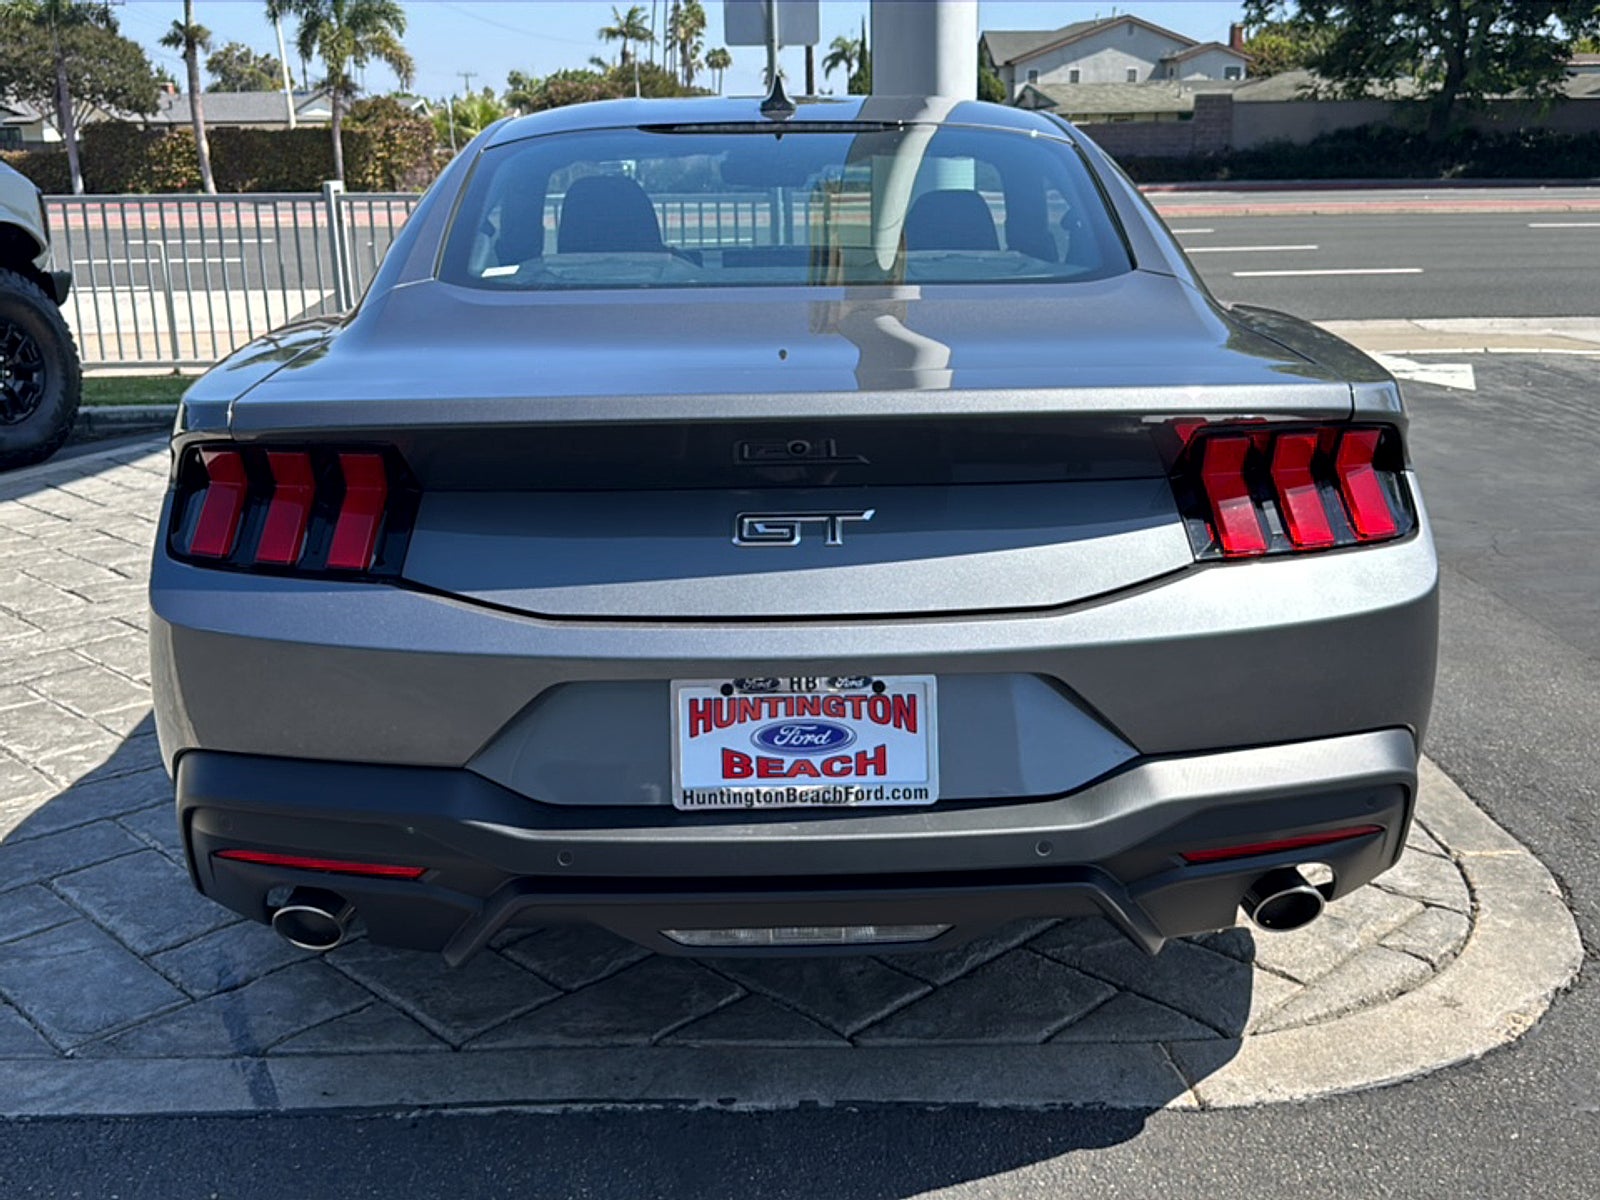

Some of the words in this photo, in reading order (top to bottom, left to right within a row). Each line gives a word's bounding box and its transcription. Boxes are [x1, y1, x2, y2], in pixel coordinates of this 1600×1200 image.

[732, 509, 875, 546] GT
[835, 677, 867, 688] Ford
[689, 694, 917, 738] HUNTINGTON
[774, 726, 832, 746] Ford
[721, 744, 887, 779] BEACH
[682, 785, 929, 806] HuntingtonBeachFord.com
